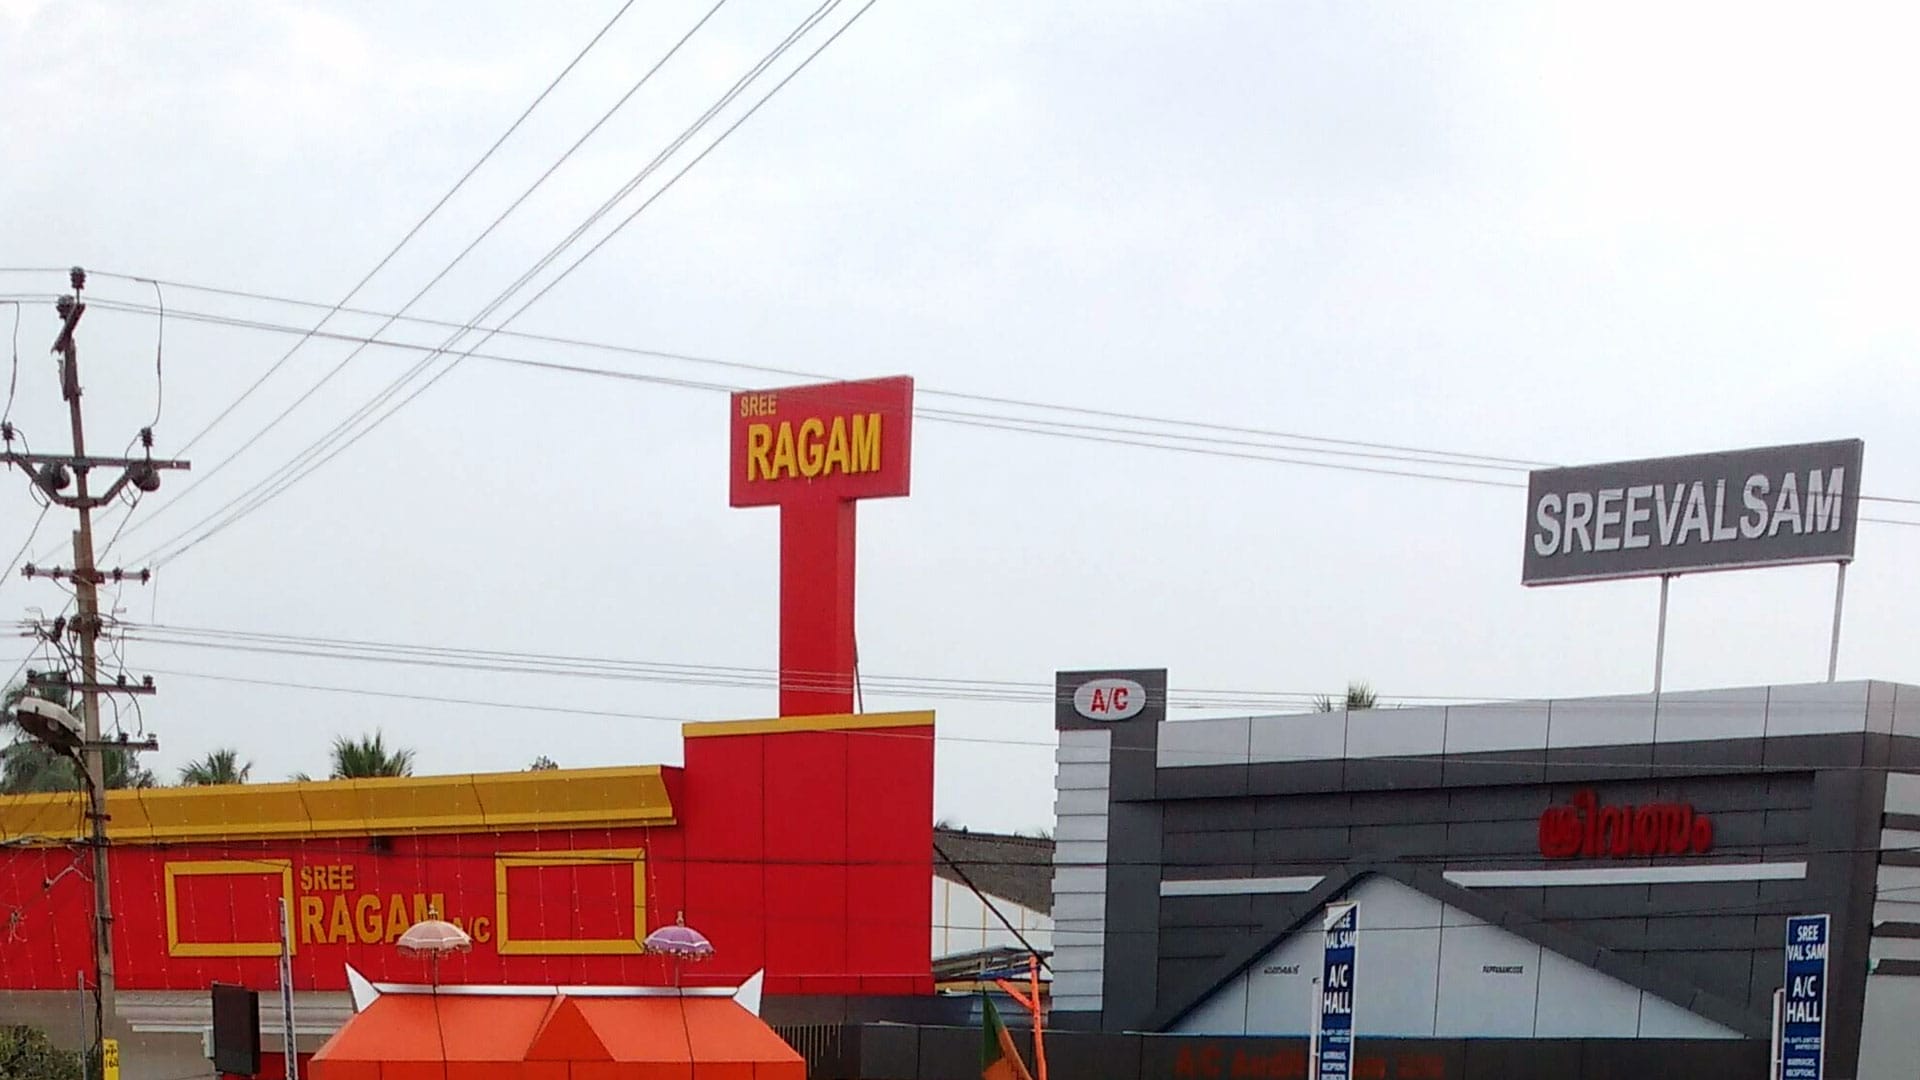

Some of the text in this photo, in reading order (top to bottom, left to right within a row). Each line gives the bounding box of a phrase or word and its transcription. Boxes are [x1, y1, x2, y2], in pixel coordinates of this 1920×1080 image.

[740, 394, 777, 417] SREE
[747, 413, 882, 482] RAGAM
[1533, 466, 1846, 557] SREEVALSAM
[1090, 687, 1129, 714] A/C
[300, 865, 355, 891] SREE
[300, 893, 445, 944] RAGAM
[1797, 924, 1820, 942] SREE
[1787, 943, 1826, 961] VAL SAM
[1328, 964, 1349, 988] A/C
[1792, 975, 1817, 998] A/C
[1323, 991, 1351, 1015] HALL
[1786, 1000, 1820, 1023] HALL
